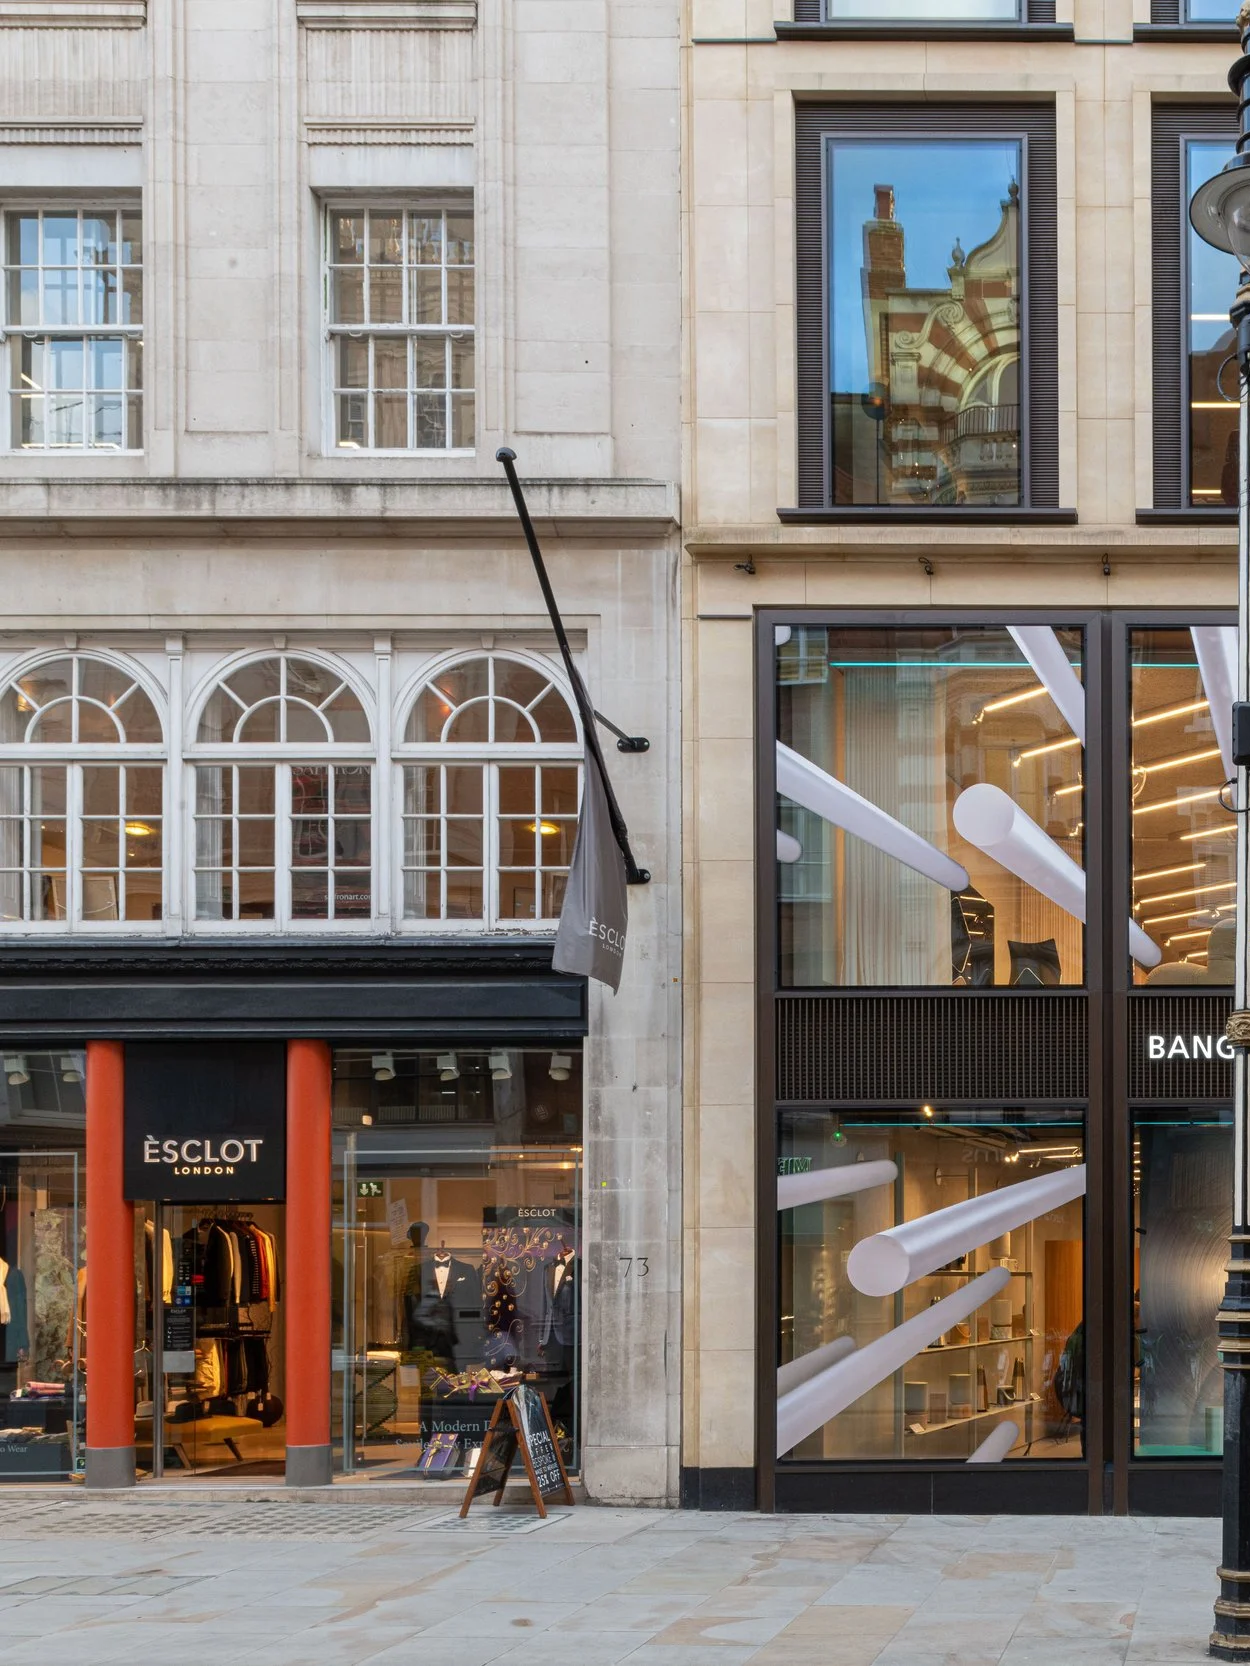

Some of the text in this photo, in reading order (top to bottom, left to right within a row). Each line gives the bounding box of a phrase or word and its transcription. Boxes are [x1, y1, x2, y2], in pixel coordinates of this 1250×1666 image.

[1149, 1035, 1235, 1059] BANG
[143, 1135, 263, 1163] ÈSCLOT
[174, 1166, 235, 1175] LONDON
[518, 1208, 556, 1217] ÈSCLOT
[619, 1257, 649, 1278] 73
[420, 1423, 427, 1432] A
[432, 1420, 480, 1432] Modern
[7, 1445, 28, 1453] Wear
[537, 1468, 561, 1488] 25% OFF
